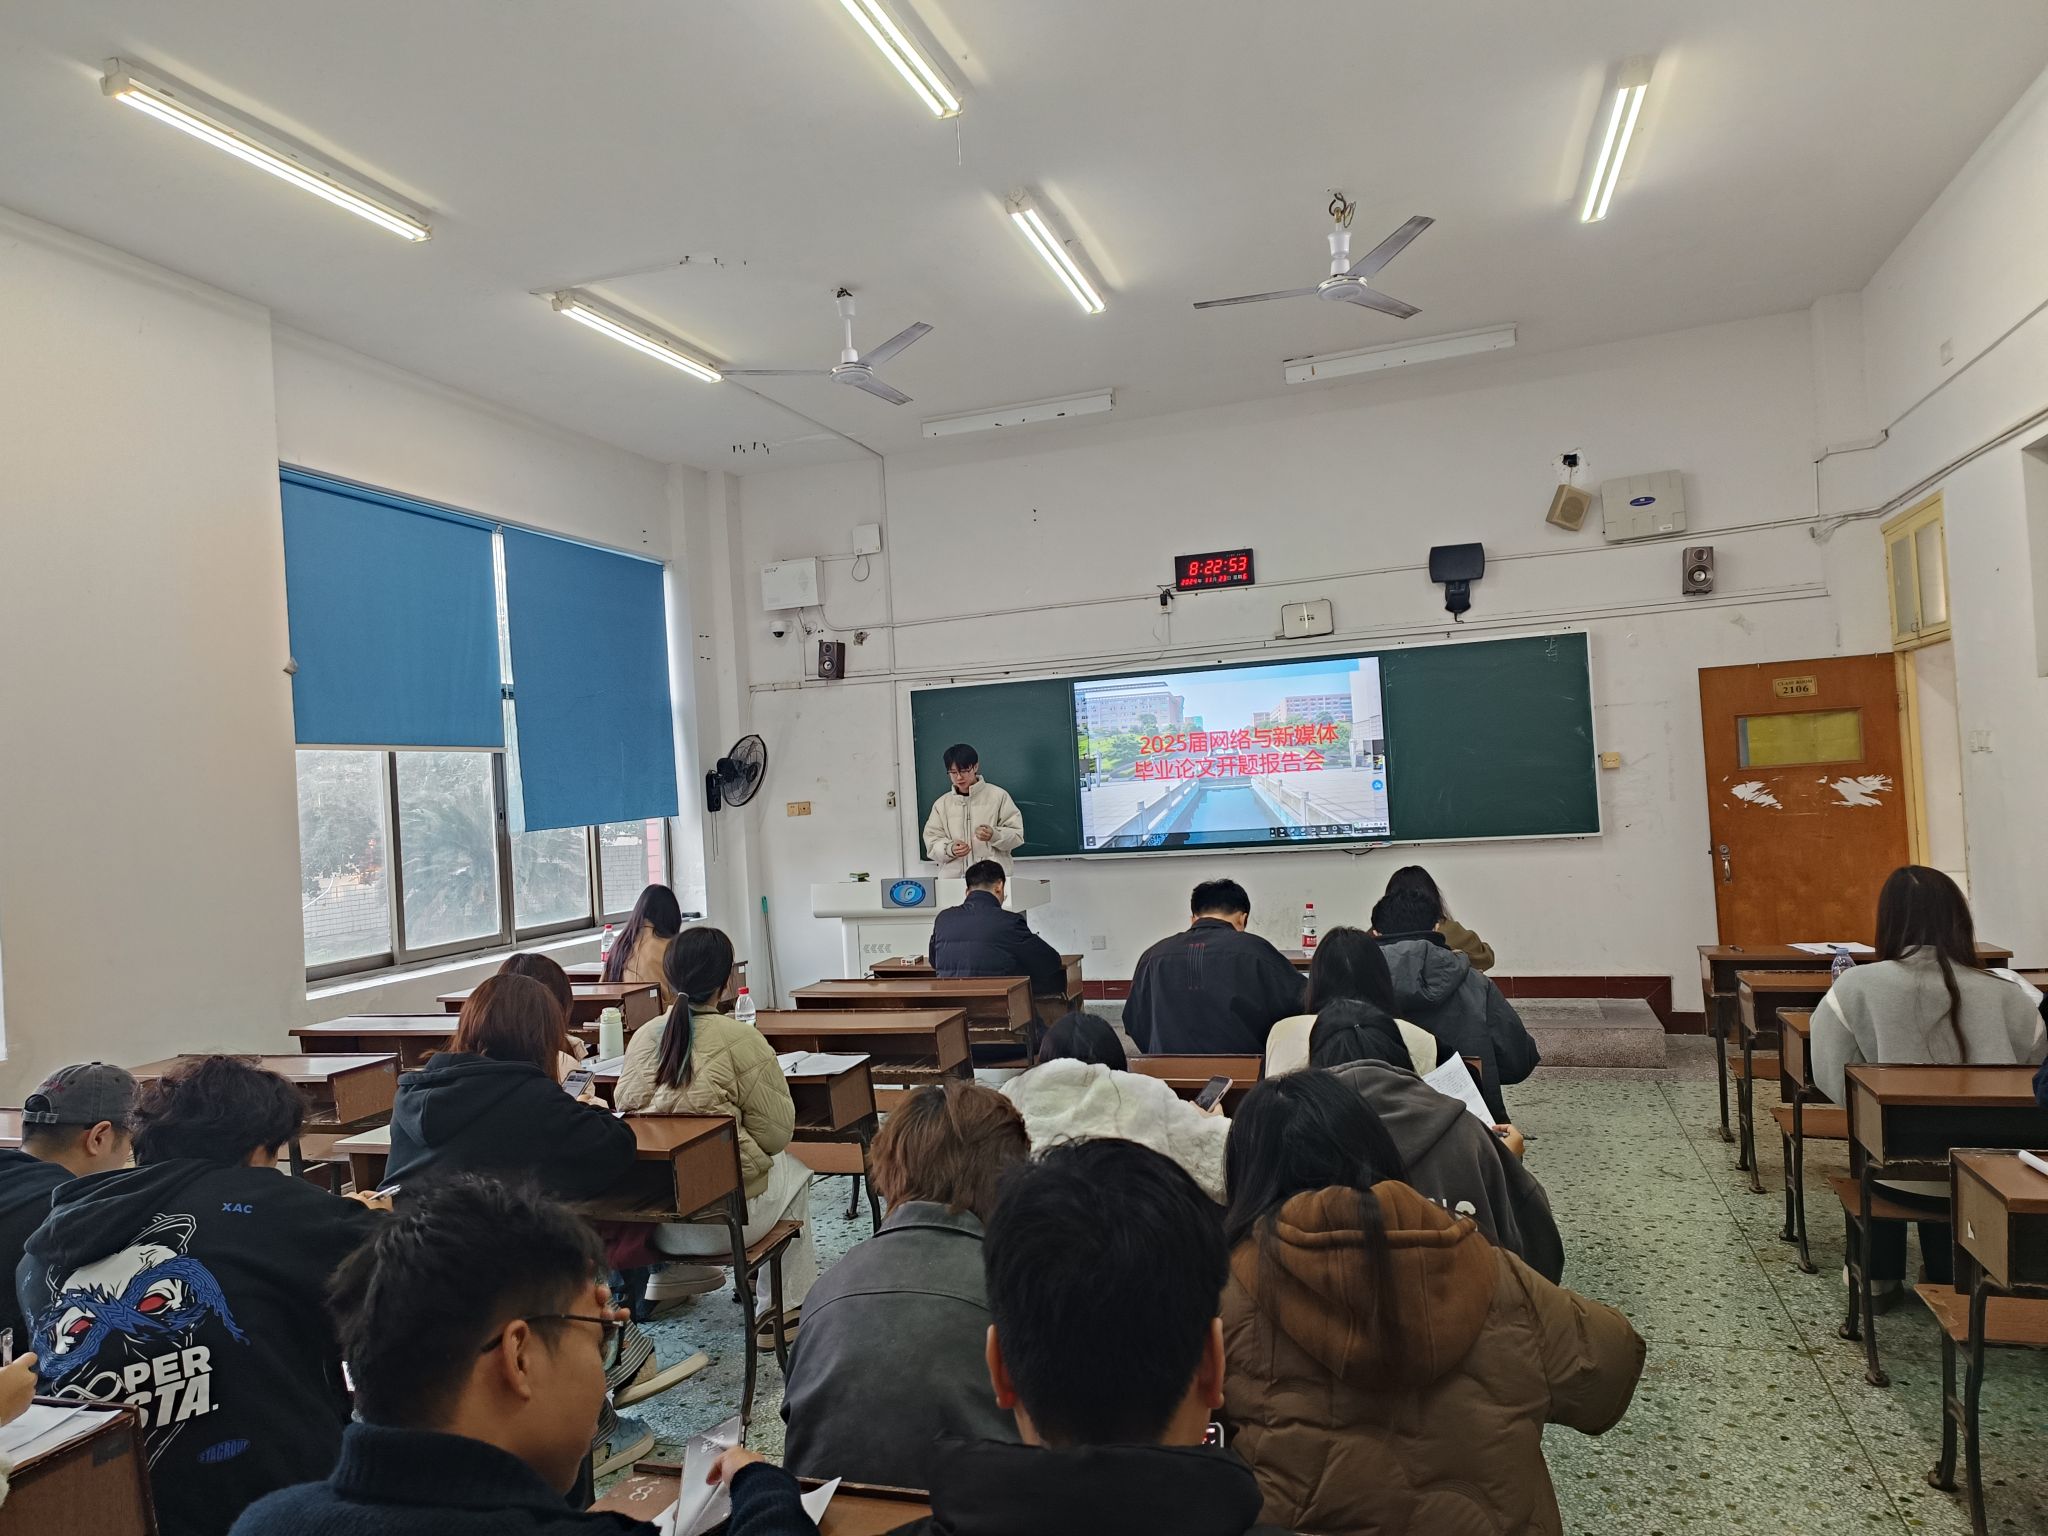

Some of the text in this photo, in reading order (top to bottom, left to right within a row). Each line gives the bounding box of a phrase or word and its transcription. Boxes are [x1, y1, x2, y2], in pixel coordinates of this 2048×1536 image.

[1189, 556, 1248, 576] 8:22:53
[1783, 685, 1809, 694] 2106
[1140, 722, 1339, 754] 2025届网络与新媒体
[1135, 749, 1325, 781] 毕业论文开题报告会
[221, 1202, 253, 1214] XAC
